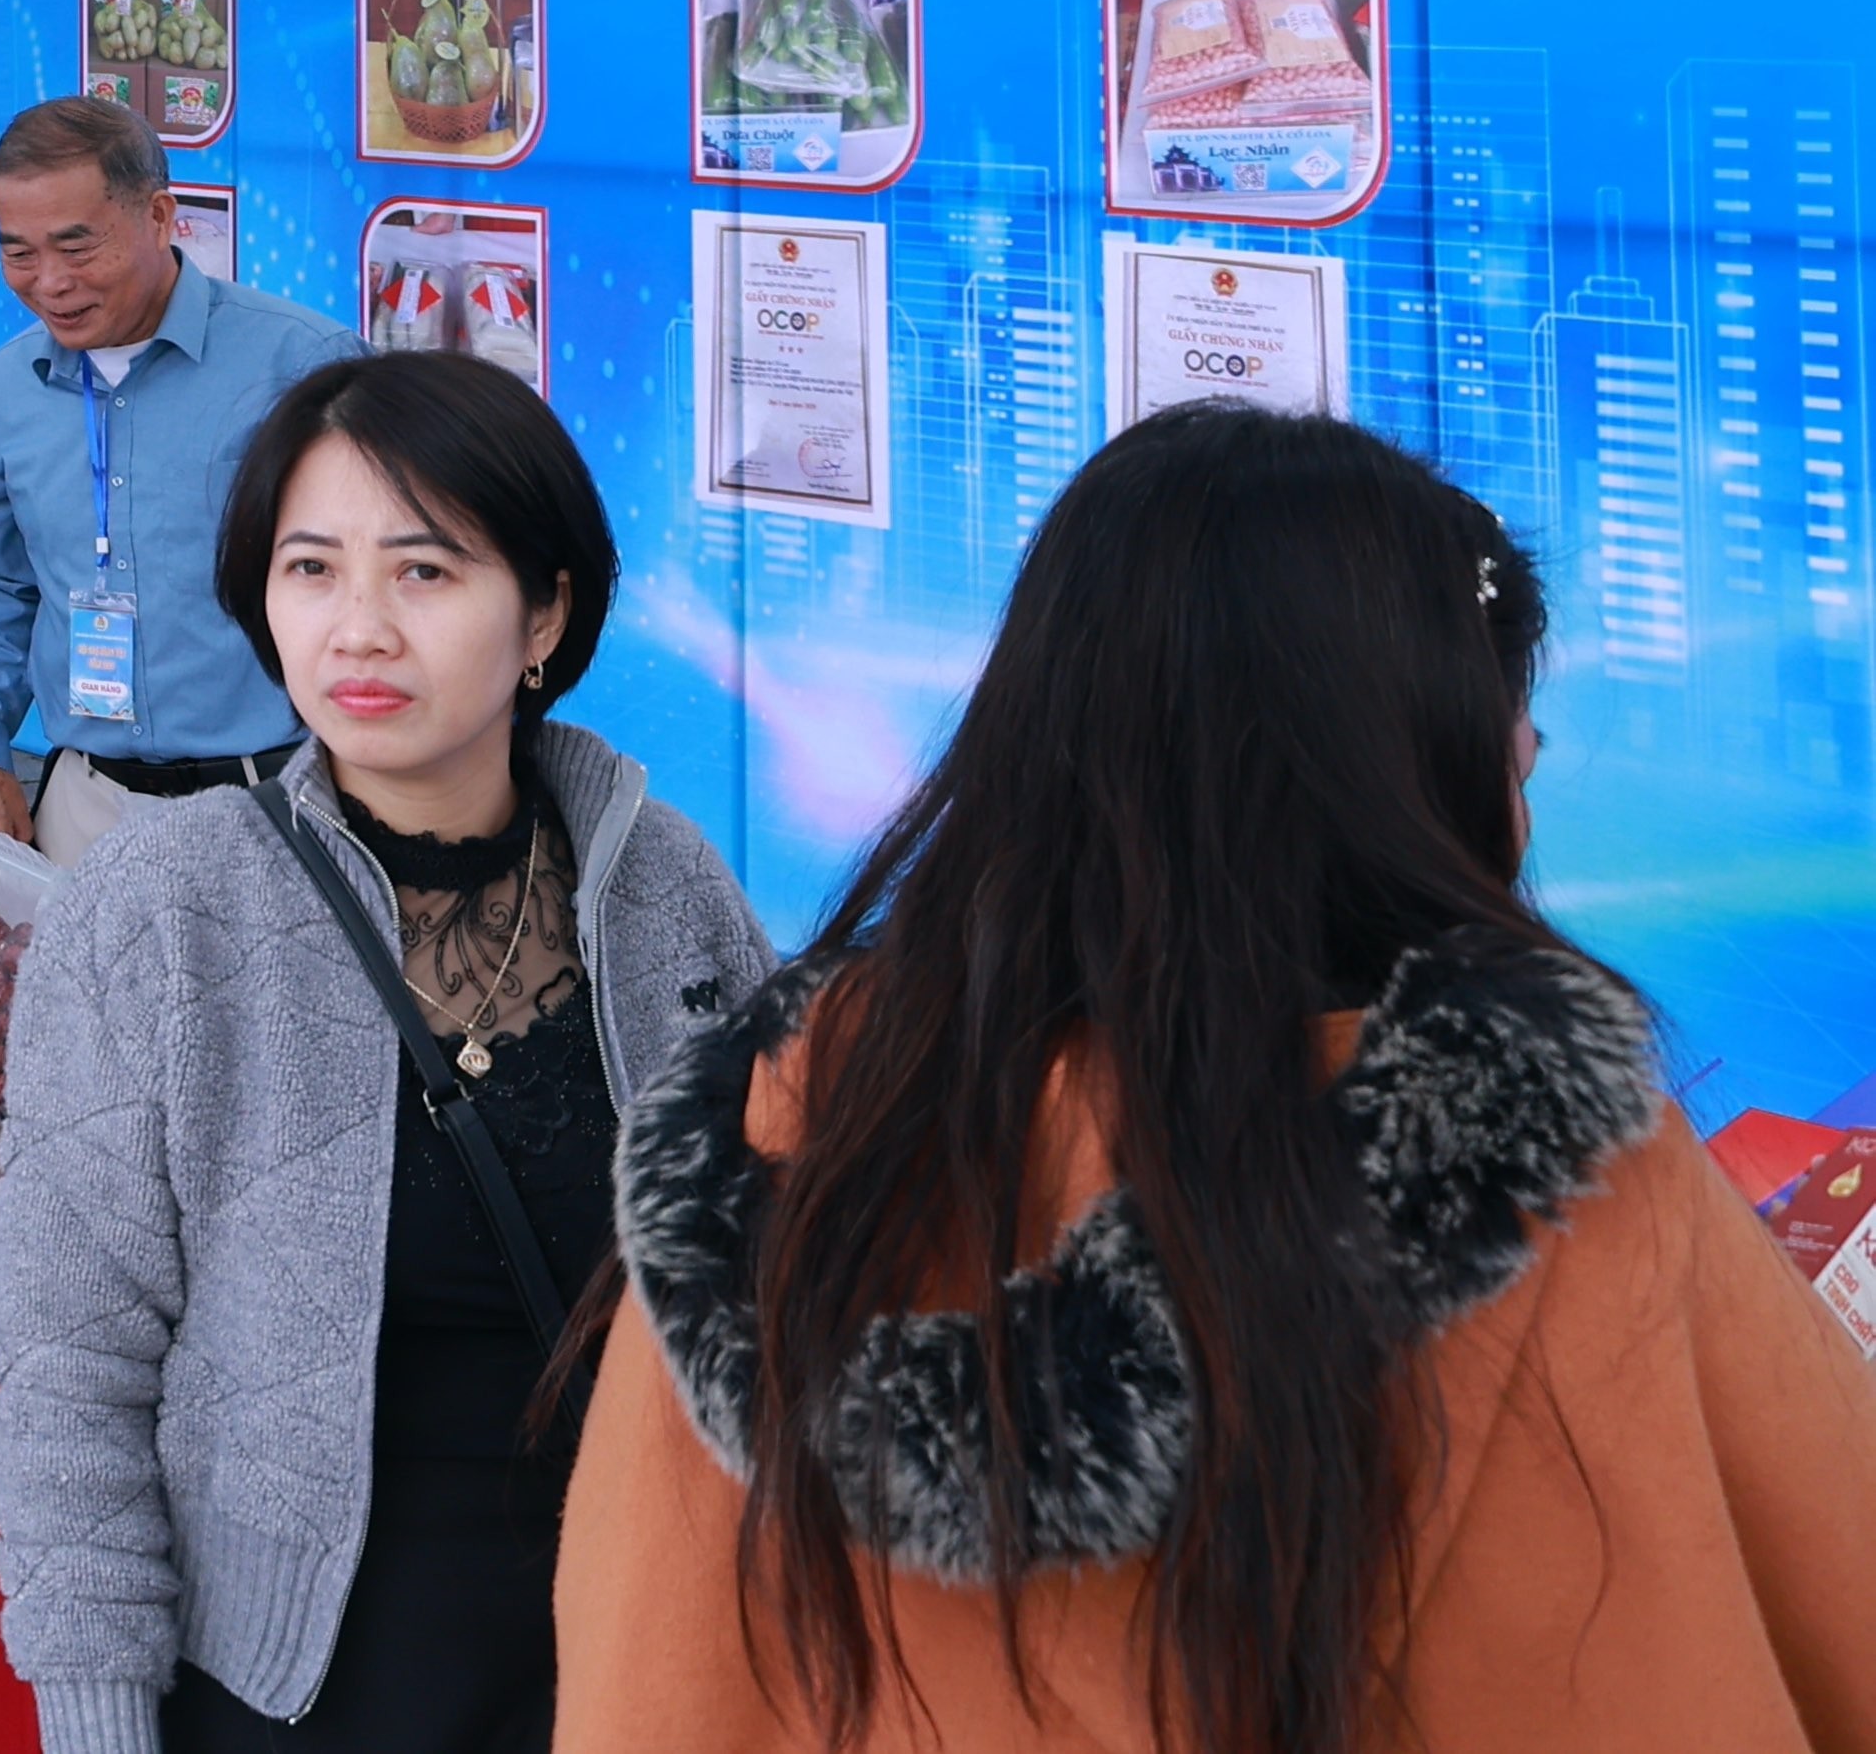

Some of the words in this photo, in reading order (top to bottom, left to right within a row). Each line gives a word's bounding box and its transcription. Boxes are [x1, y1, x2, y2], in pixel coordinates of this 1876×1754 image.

[722, 129, 749, 141] Dưa
[752, 128, 795, 142] Chuột
[1208, 145, 1241, 162] Lạc
[1244, 144, 1290, 157] Nhân
[745, 290, 768, 303] GIẤY
[756, 308, 820, 332] OCOP
[1168, 326, 1198, 343] GIẤY
[1200, 329, 1245, 348] CHỨNG
[1248, 337, 1284, 354] NHẬN
[1184, 349, 1263, 379] OCOP
[100, 682, 121, 694] HÀNG
